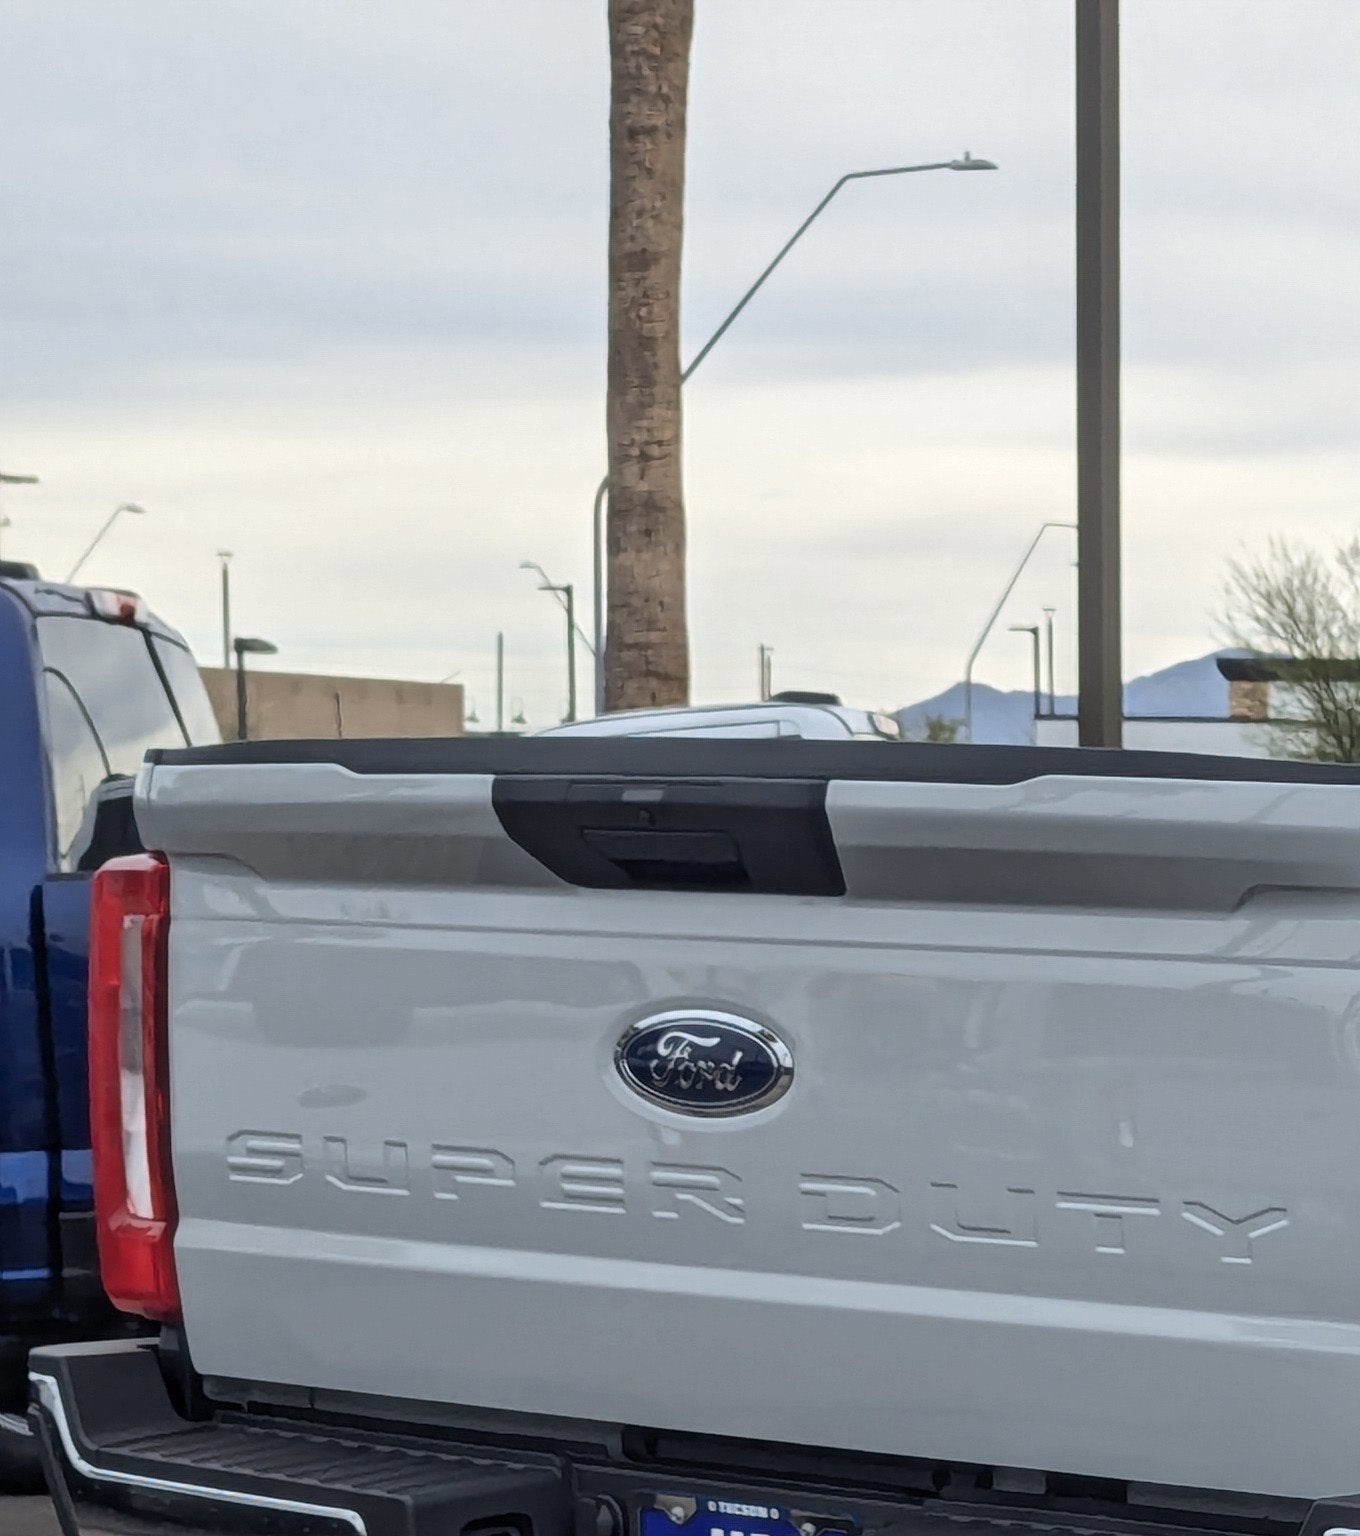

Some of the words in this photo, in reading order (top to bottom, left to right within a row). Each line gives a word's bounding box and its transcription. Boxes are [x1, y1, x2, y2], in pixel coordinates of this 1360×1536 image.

[650, 1031, 744, 1091] Ford
[226, 1128, 746, 1225] SUPER
[799, 1173, 1289, 1265] DUTY
